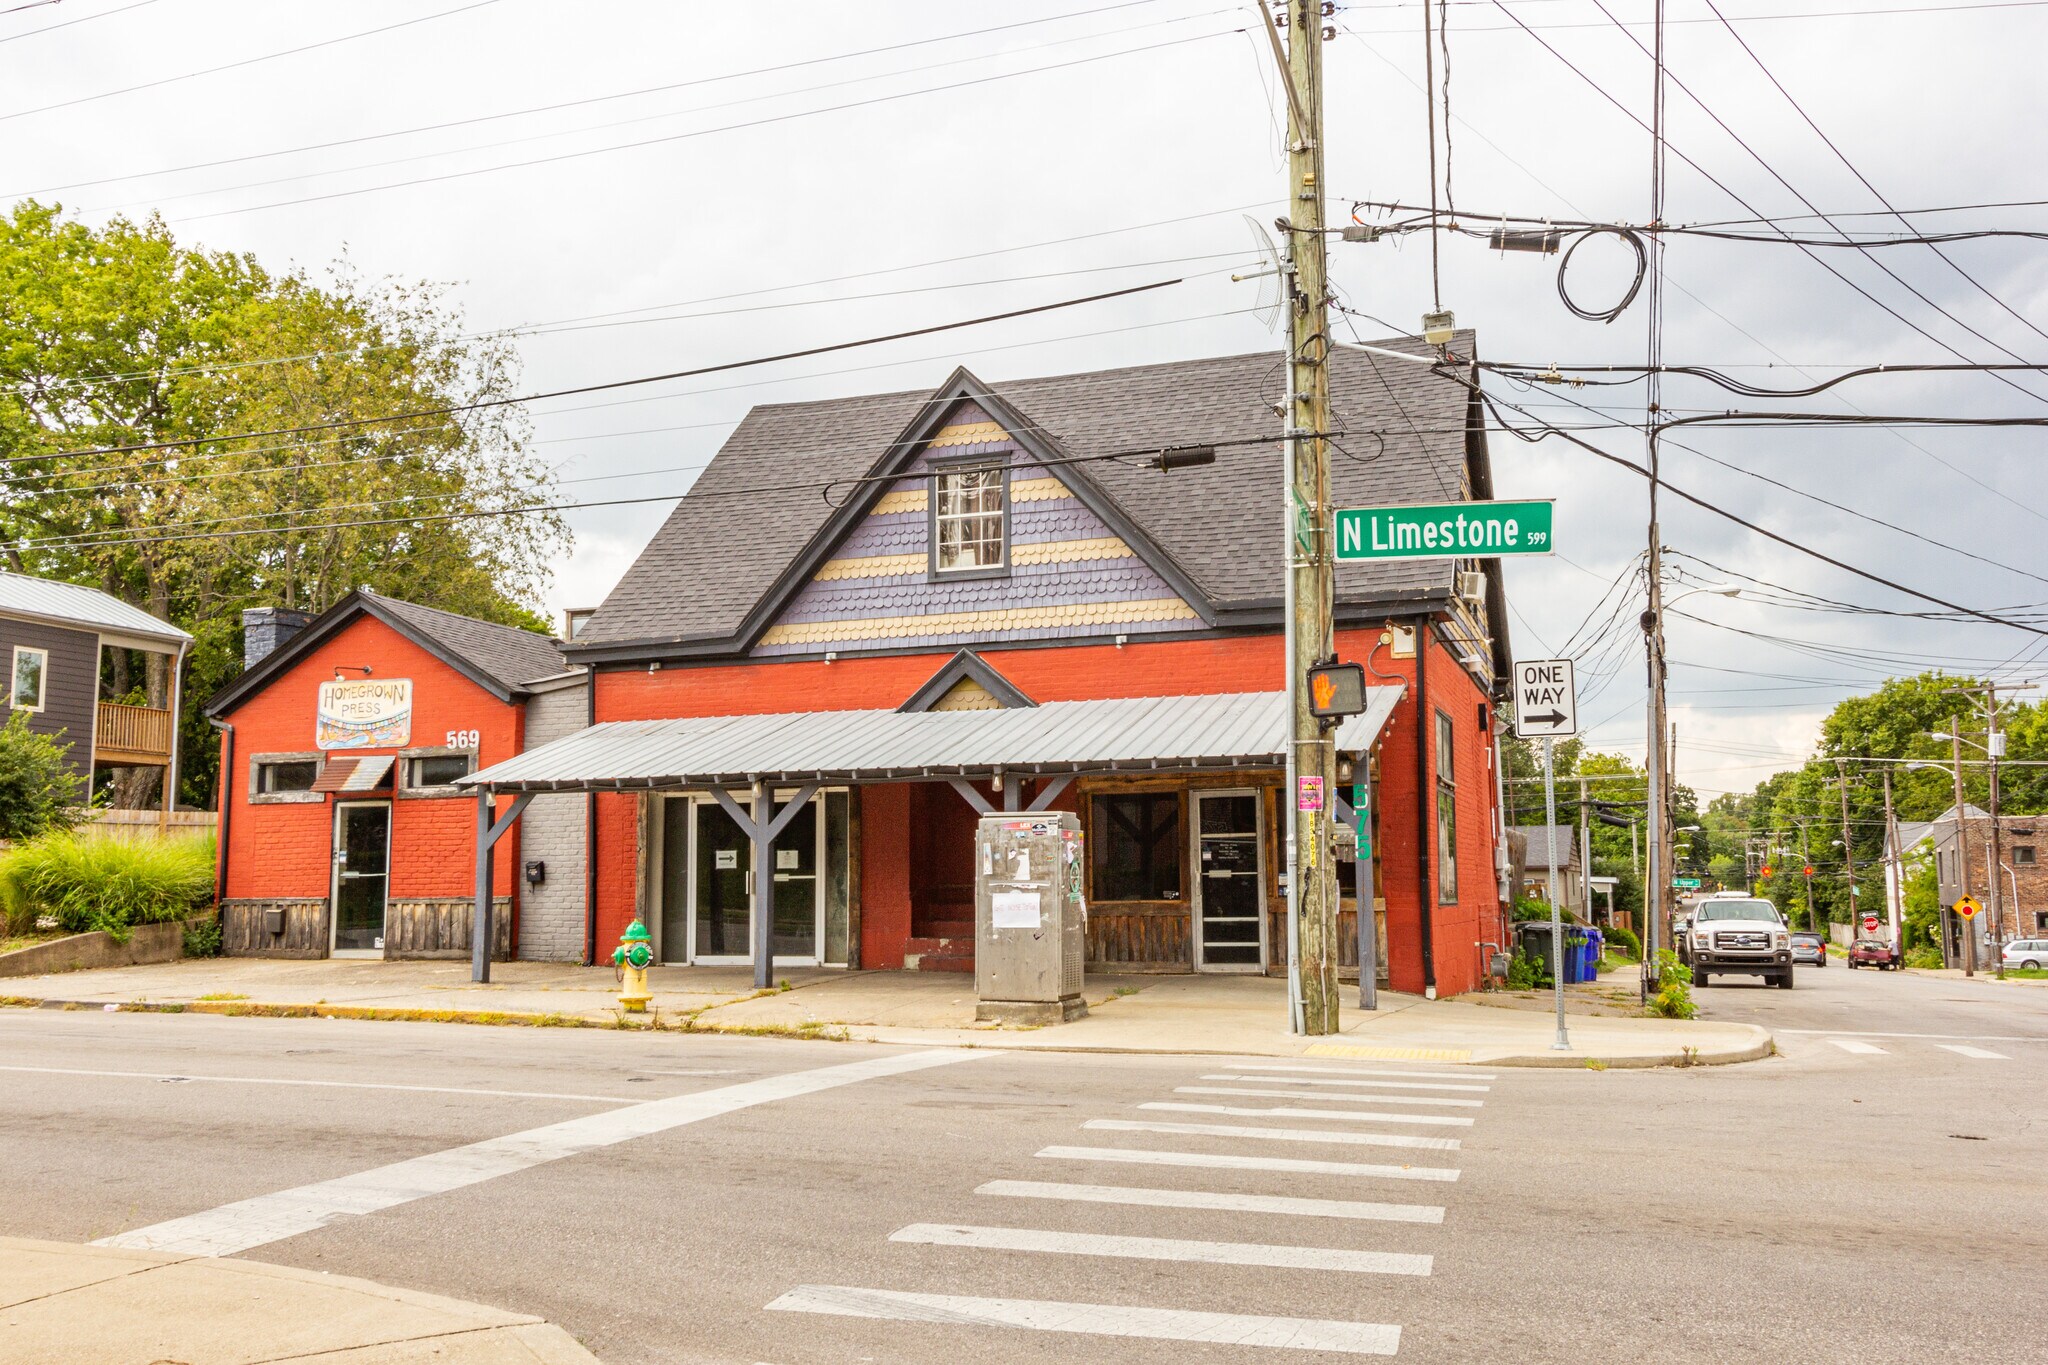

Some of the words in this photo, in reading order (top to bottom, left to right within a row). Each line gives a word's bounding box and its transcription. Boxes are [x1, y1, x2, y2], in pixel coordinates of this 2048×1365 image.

[1343, 517, 1360, 551] N
[1371, 513, 1519, 550] Limestone
[1527, 532, 1546, 546] 599
[1525, 666, 1564, 684] ONE
[324, 684, 404, 710] HOMEGROWN
[1524, 687, 1565, 705] WAY
[341, 702, 381, 717] PRESS
[446, 730, 480, 750] 569
[1353, 783, 1371, 860] 575
